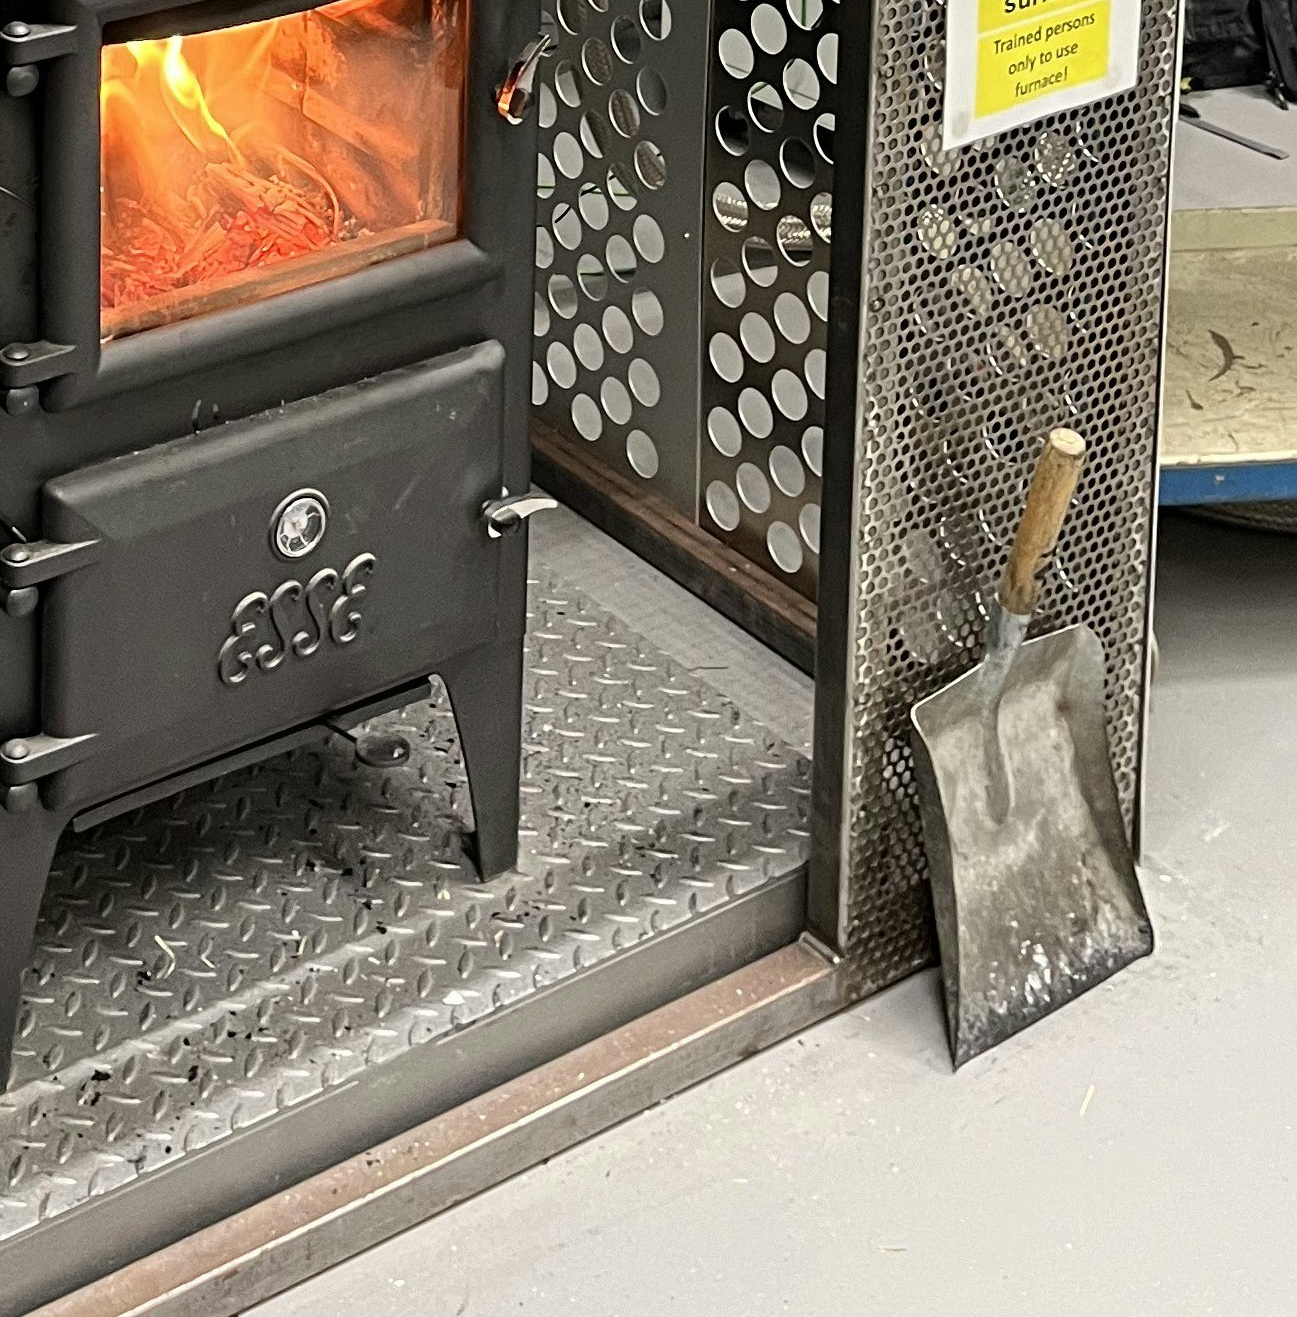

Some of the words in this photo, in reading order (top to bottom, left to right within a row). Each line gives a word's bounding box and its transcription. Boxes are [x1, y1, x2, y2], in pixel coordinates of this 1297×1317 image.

[994, 26, 1042, 55] Trained
[1045, 12, 1096, 42] persons
[1008, 55, 1037, 75] only
[1039, 51, 1053, 65] to
[1056, 42, 1079, 58] use
[1014, 65, 1068, 98] furnace!
